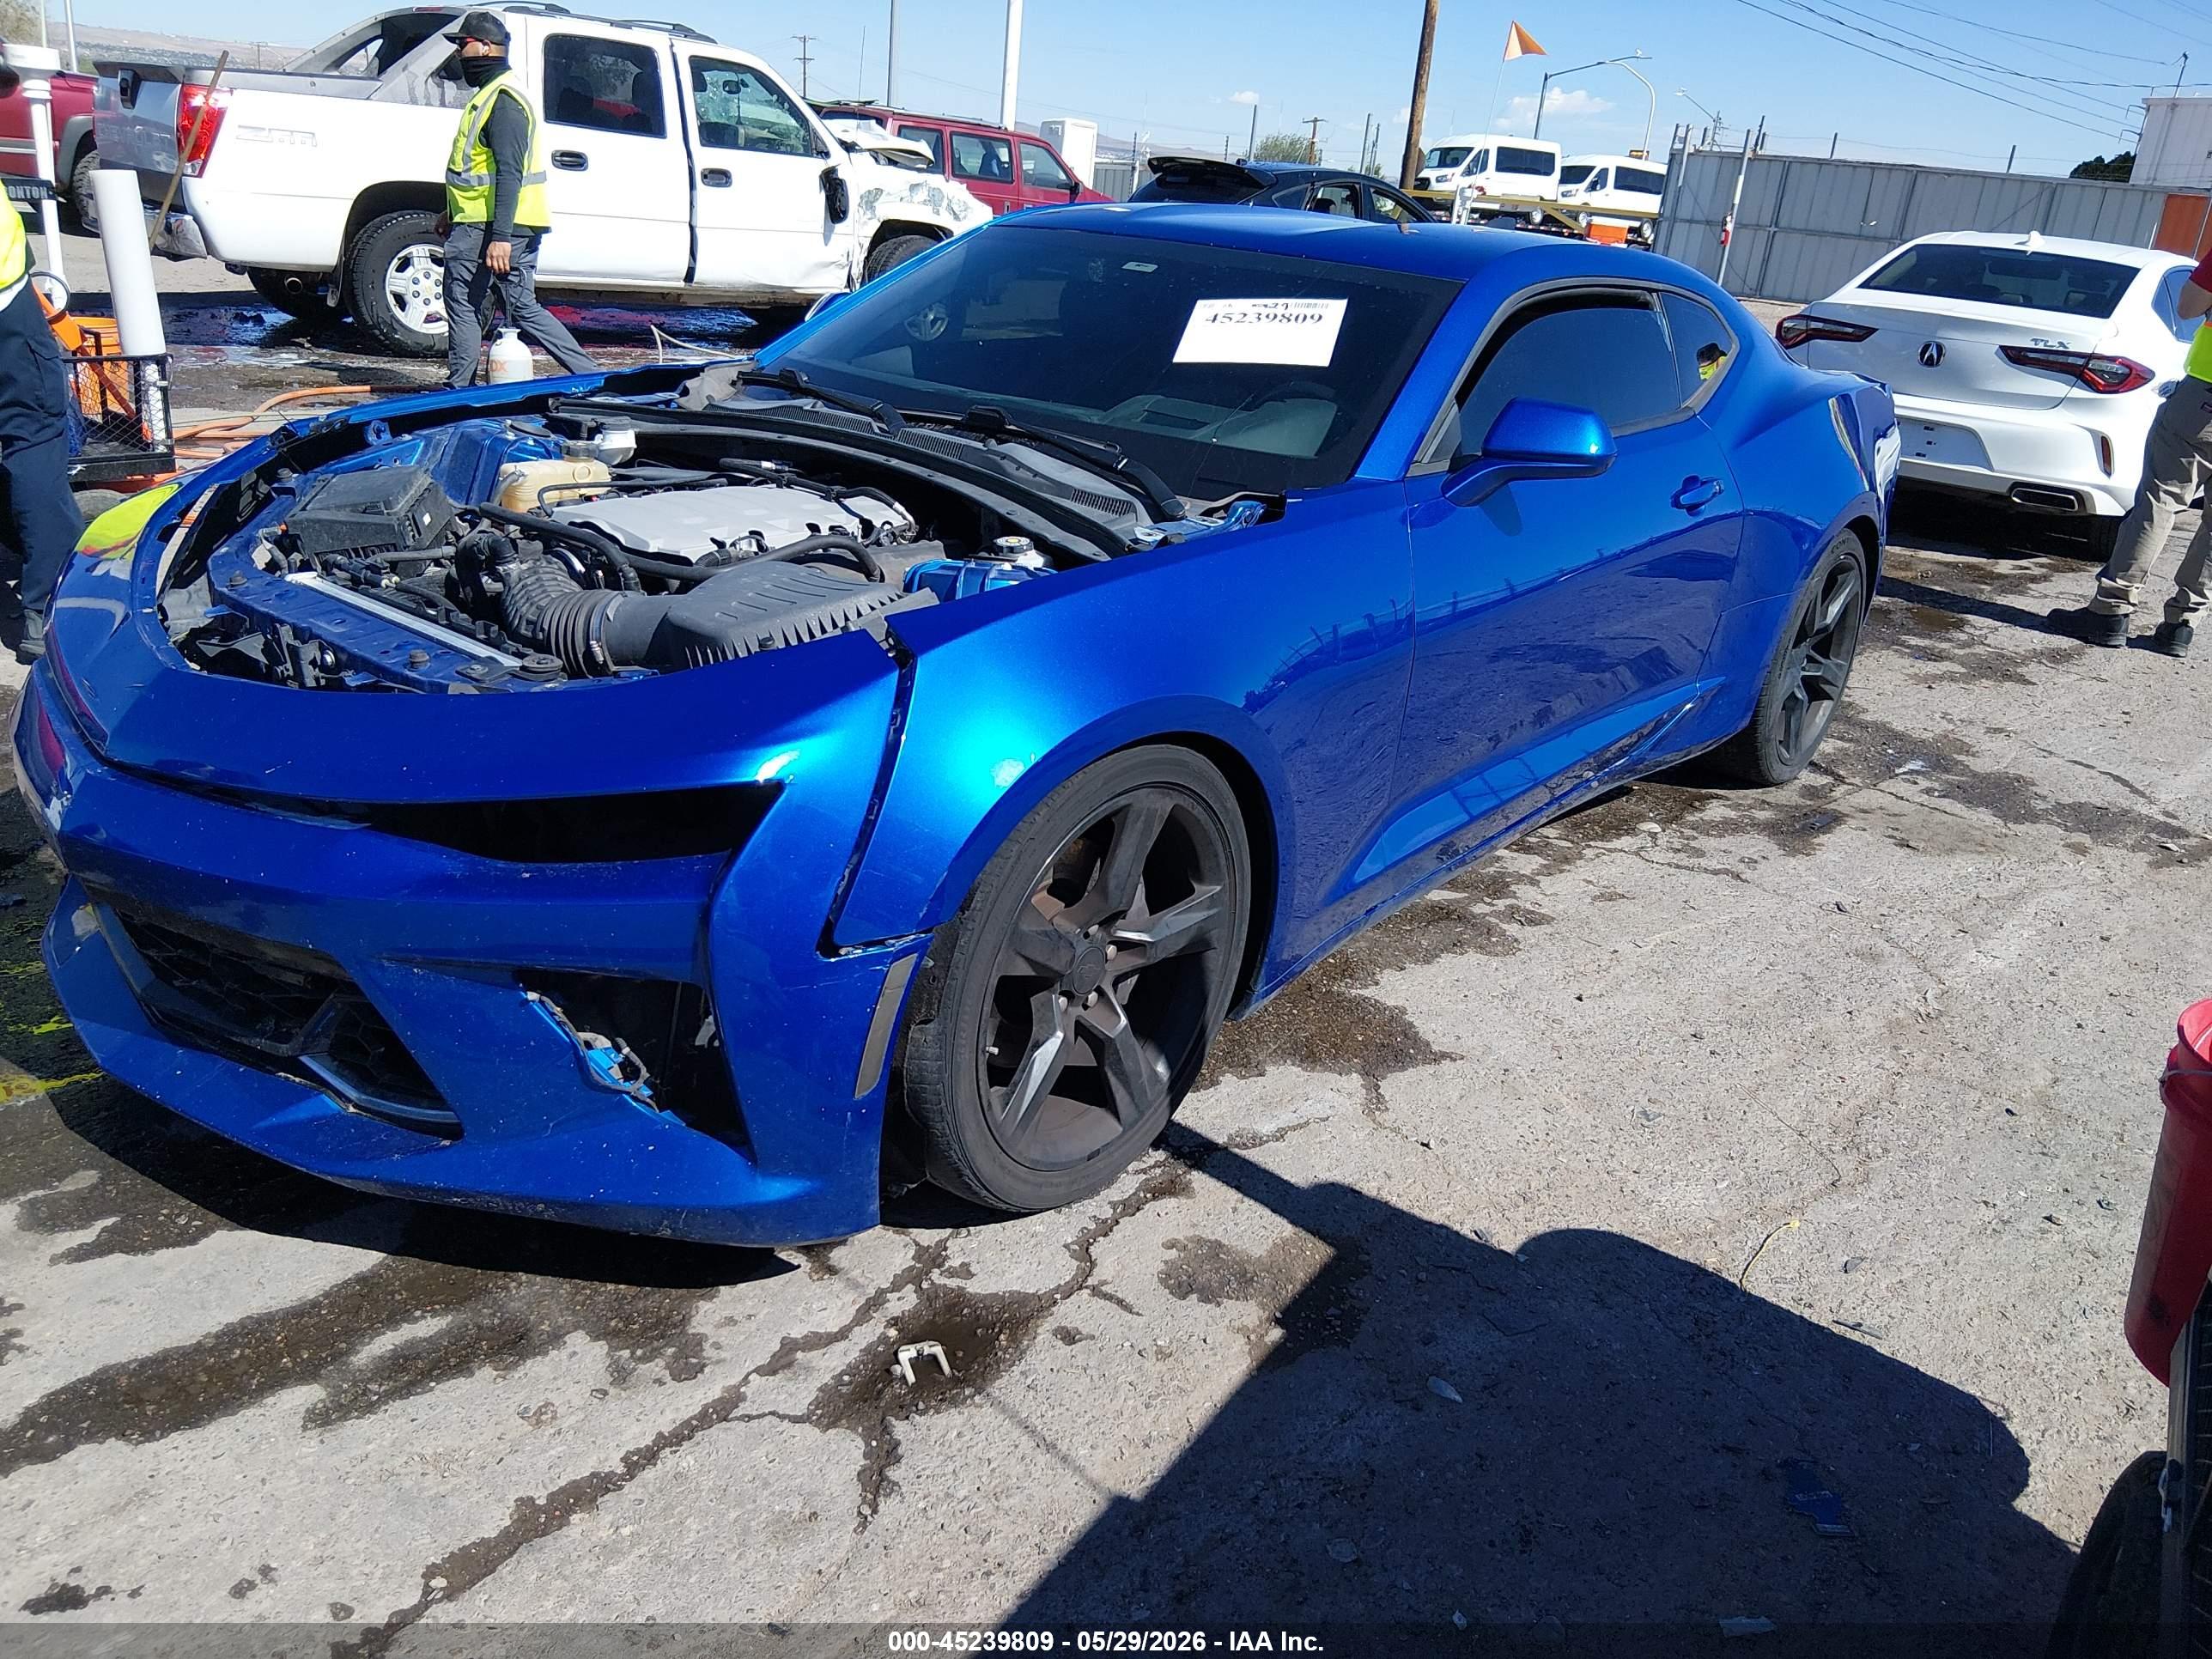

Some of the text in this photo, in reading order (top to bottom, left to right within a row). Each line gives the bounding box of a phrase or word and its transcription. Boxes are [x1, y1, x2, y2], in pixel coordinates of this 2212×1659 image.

[6, 185, 48, 199] ONTON
[1205, 313, 1323, 324] 45239809
[2030, 337, 2072, 349] TLX
